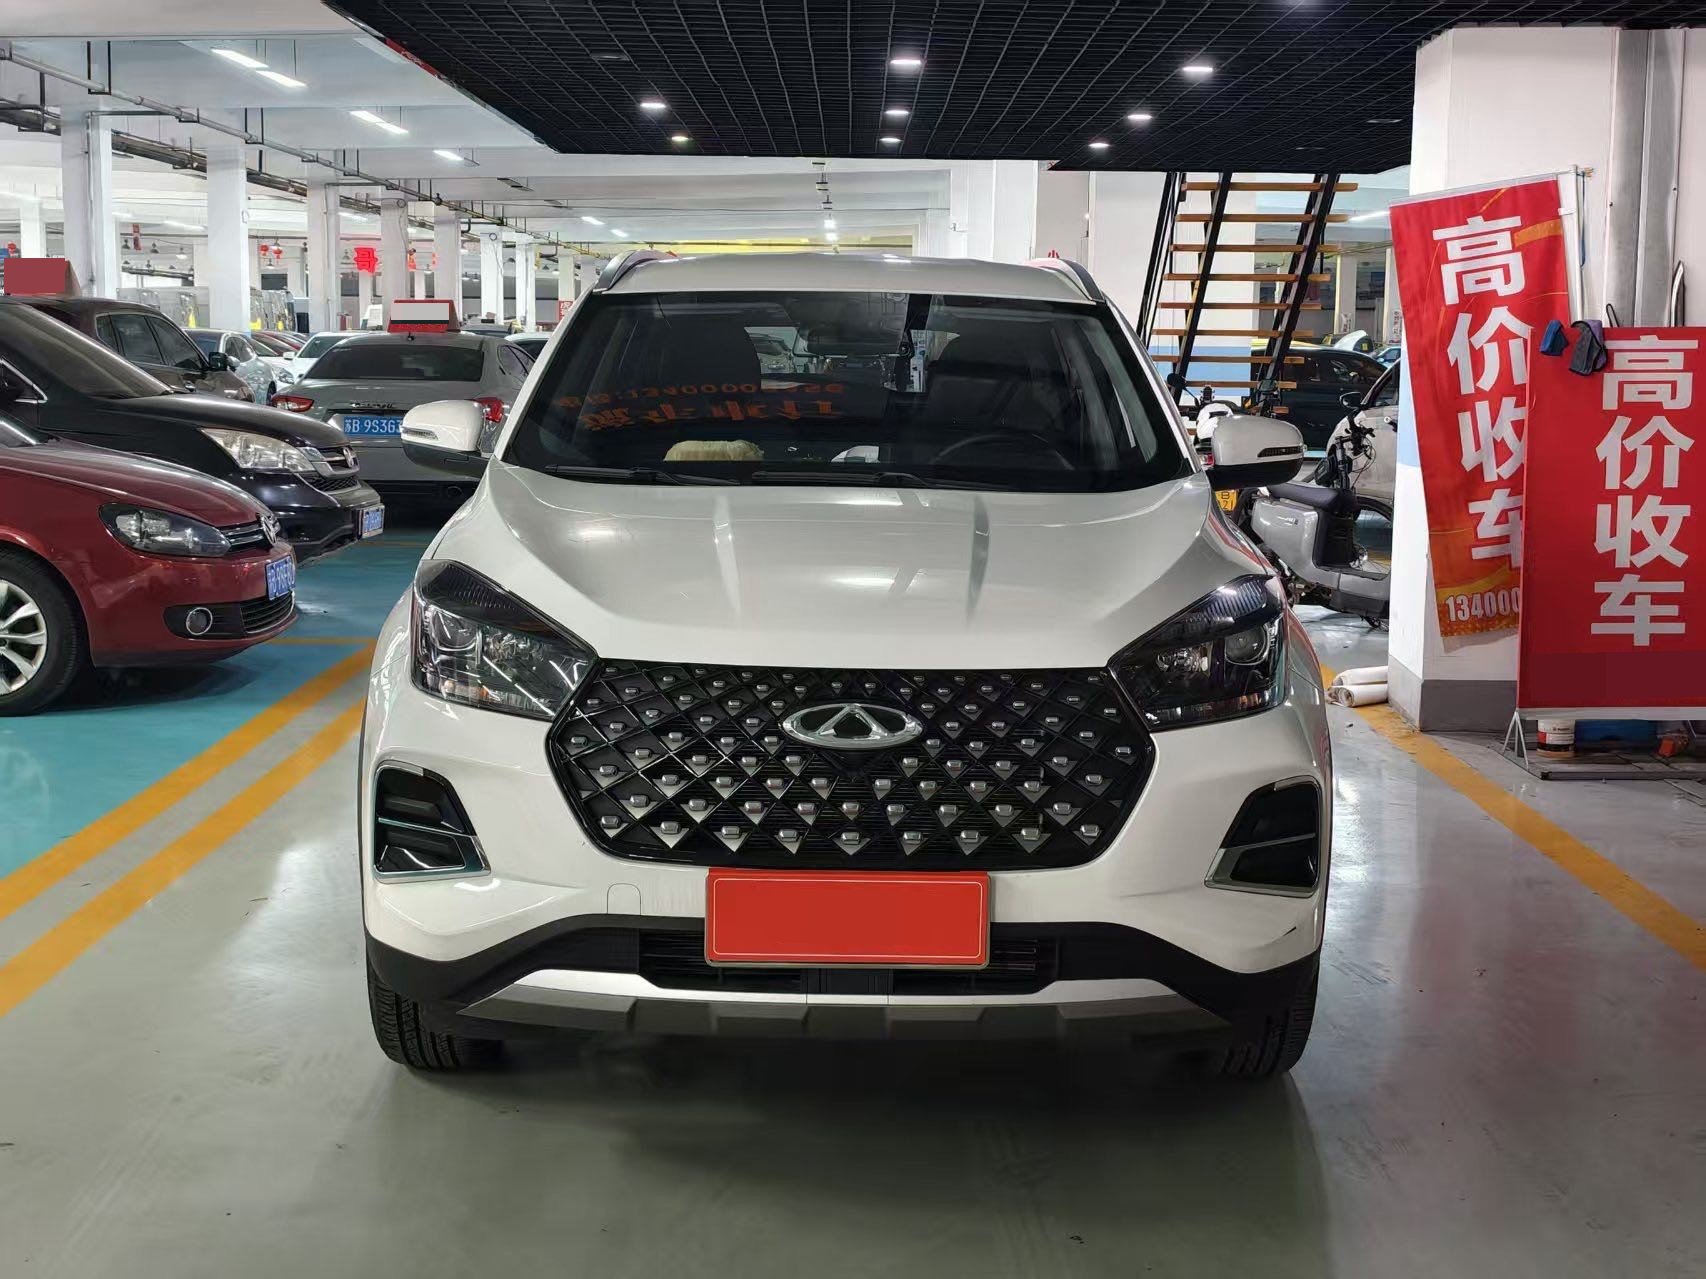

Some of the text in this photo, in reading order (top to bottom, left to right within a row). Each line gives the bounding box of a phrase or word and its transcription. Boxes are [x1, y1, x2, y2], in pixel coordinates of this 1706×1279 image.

[1432, 216, 1533, 568] 高价收车
[1591, 335, 1698, 646] 高价收车
[1445, 588, 1520, 622] 134000
